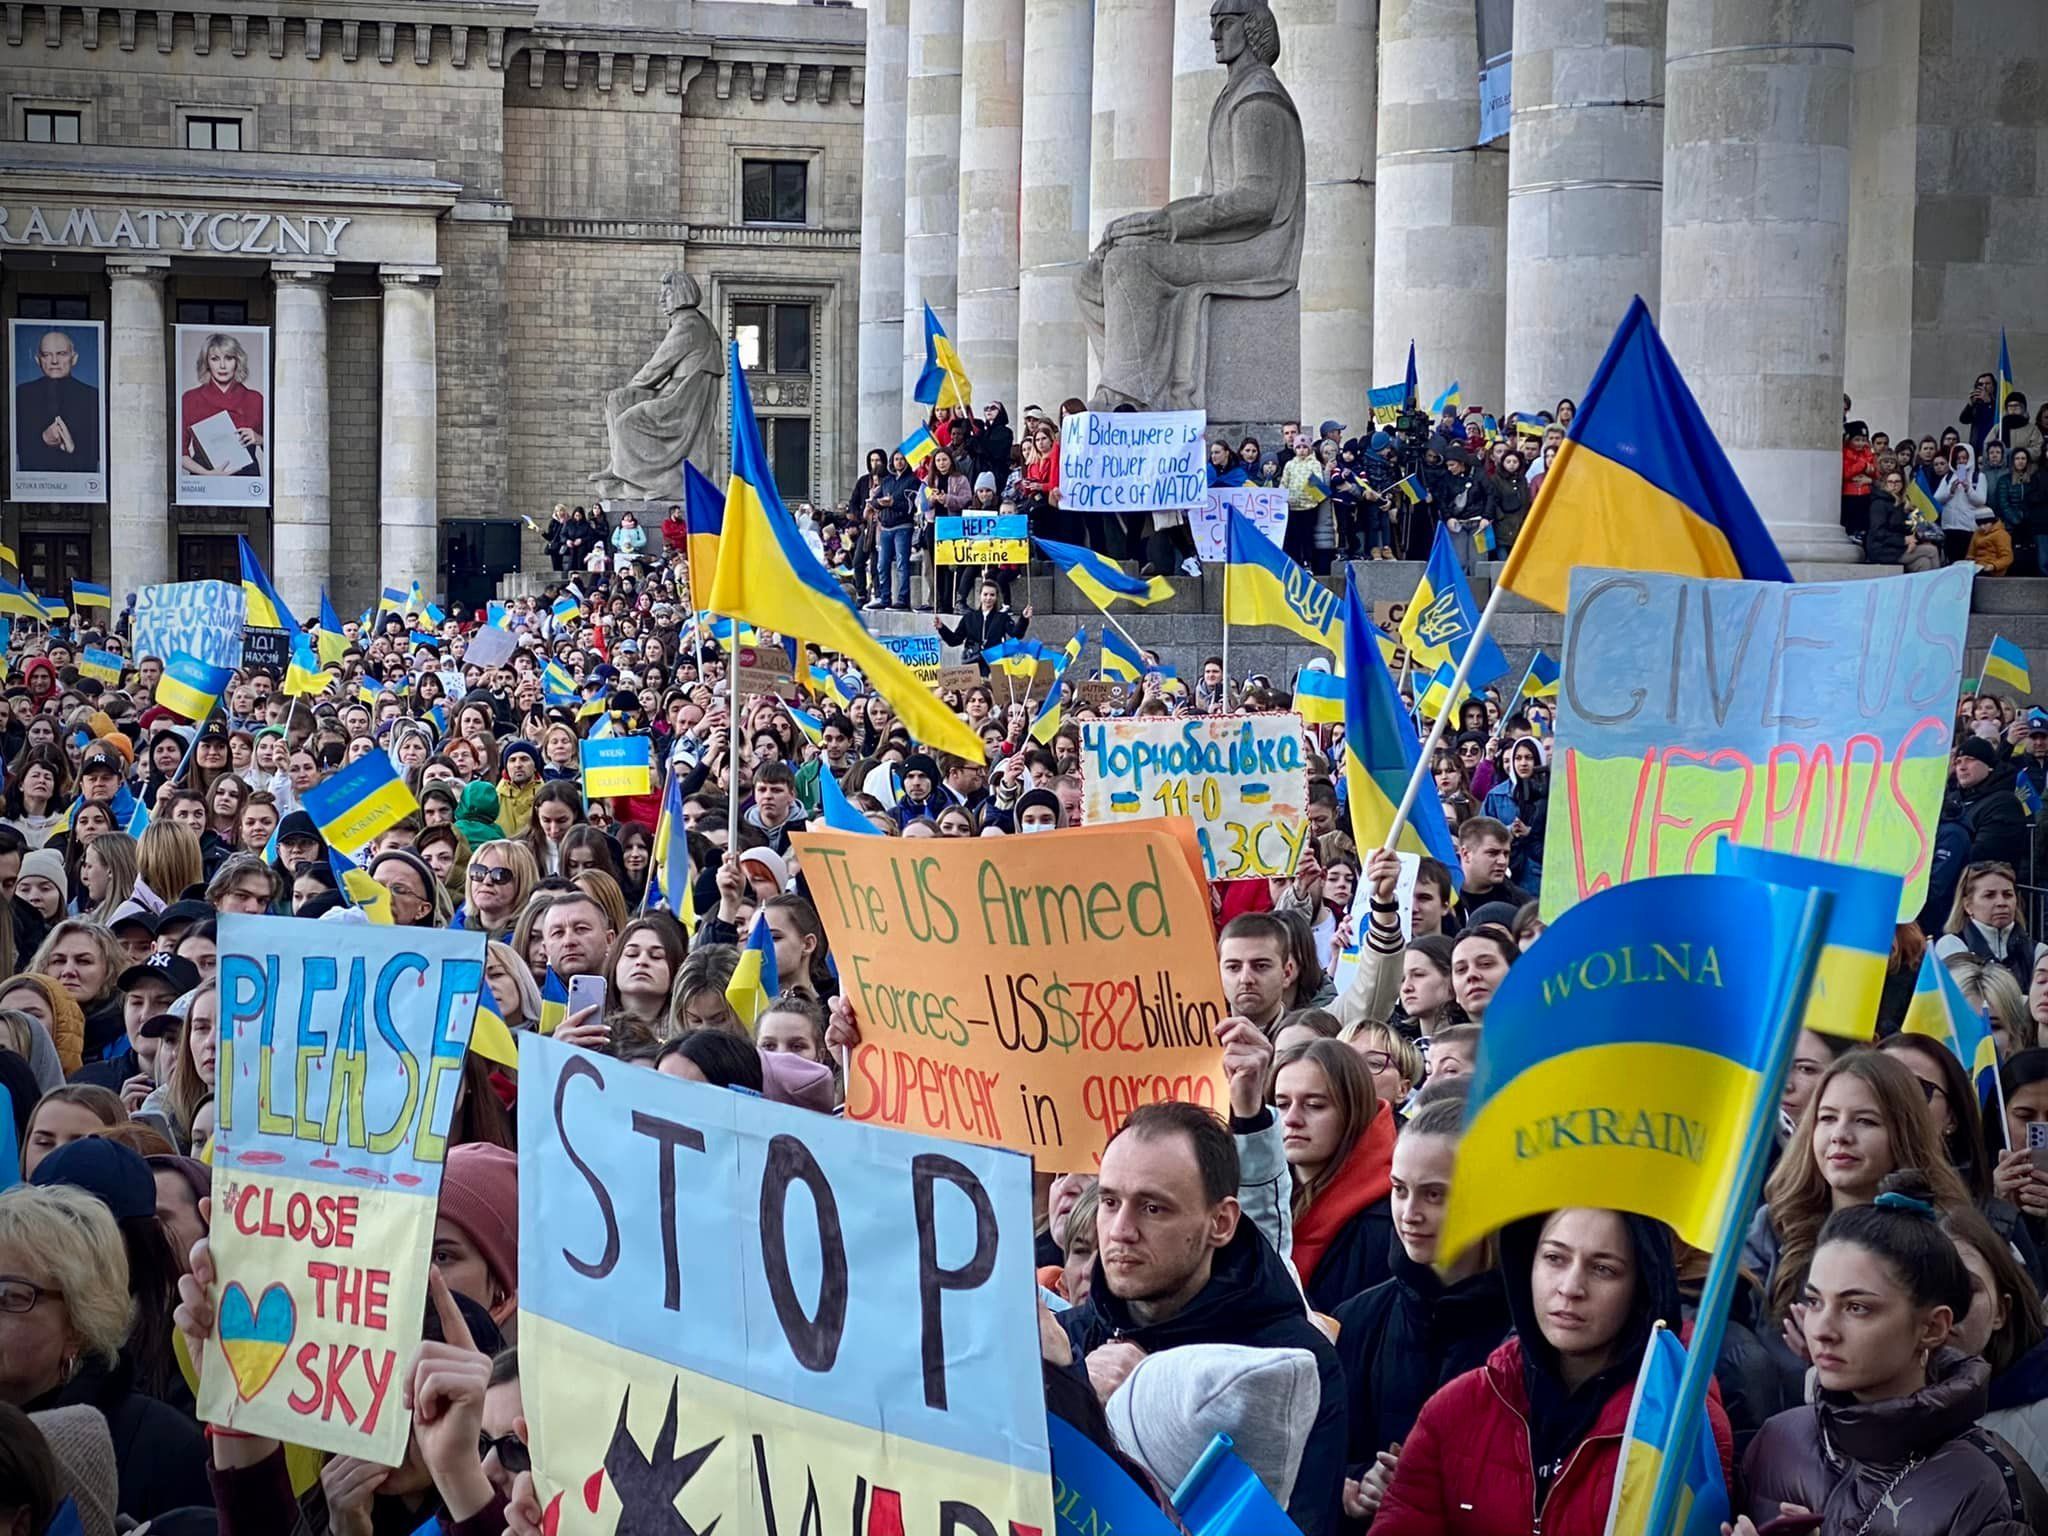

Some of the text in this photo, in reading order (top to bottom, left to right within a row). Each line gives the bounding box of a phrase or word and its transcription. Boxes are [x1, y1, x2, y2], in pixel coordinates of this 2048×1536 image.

[1183, 424, 1198, 443] is
[1064, 454, 1093, 479] the
[1158, 451, 1191, 474] and
[1068, 468, 1206, 507] force of NATO?
[953, 546, 1009, 563] Ukraine
[962, 518, 997, 537] HELP
[136, 608, 175, 630] THE
[138, 580, 245, 613] SUPPORT
[883, 637, 938, 653] TOP THE
[1857, 567, 1968, 719] US
[1153, 777, 1222, 822] 11-0
[1224, 819, 1308, 877] ЗСУ
[803, 846, 889, 935] The
[890, 856, 960, 944] US
[976, 844, 1172, 947] Armed
[1541, 943, 1724, 1007] WOLNA
[219, 952, 484, 1162] PLEASE
[1020, 1084, 1062, 1146] in
[1514, 1106, 1707, 1164] UKRAIN
[553, 1054, 999, 1412] STOP
[307, 1260, 390, 1330] THE
[287, 1342, 396, 1435] SKY
